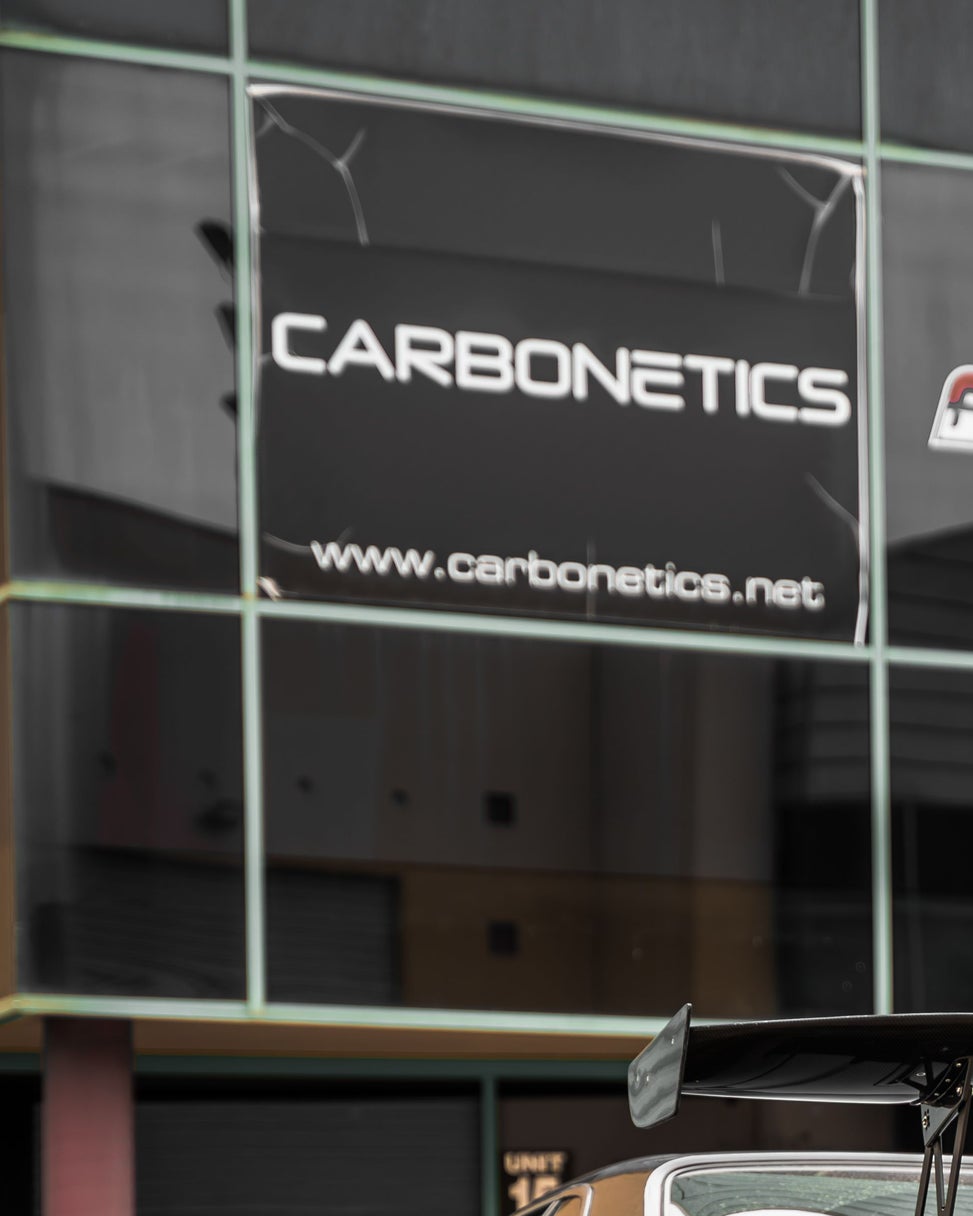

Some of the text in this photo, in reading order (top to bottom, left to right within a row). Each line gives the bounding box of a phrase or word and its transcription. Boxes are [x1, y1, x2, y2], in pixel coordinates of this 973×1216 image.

[271, 311, 852, 427] CARBONETICS
[310, 539, 826, 611] www.carbonetics.net
[503, 1151, 565, 1175] UNIT
